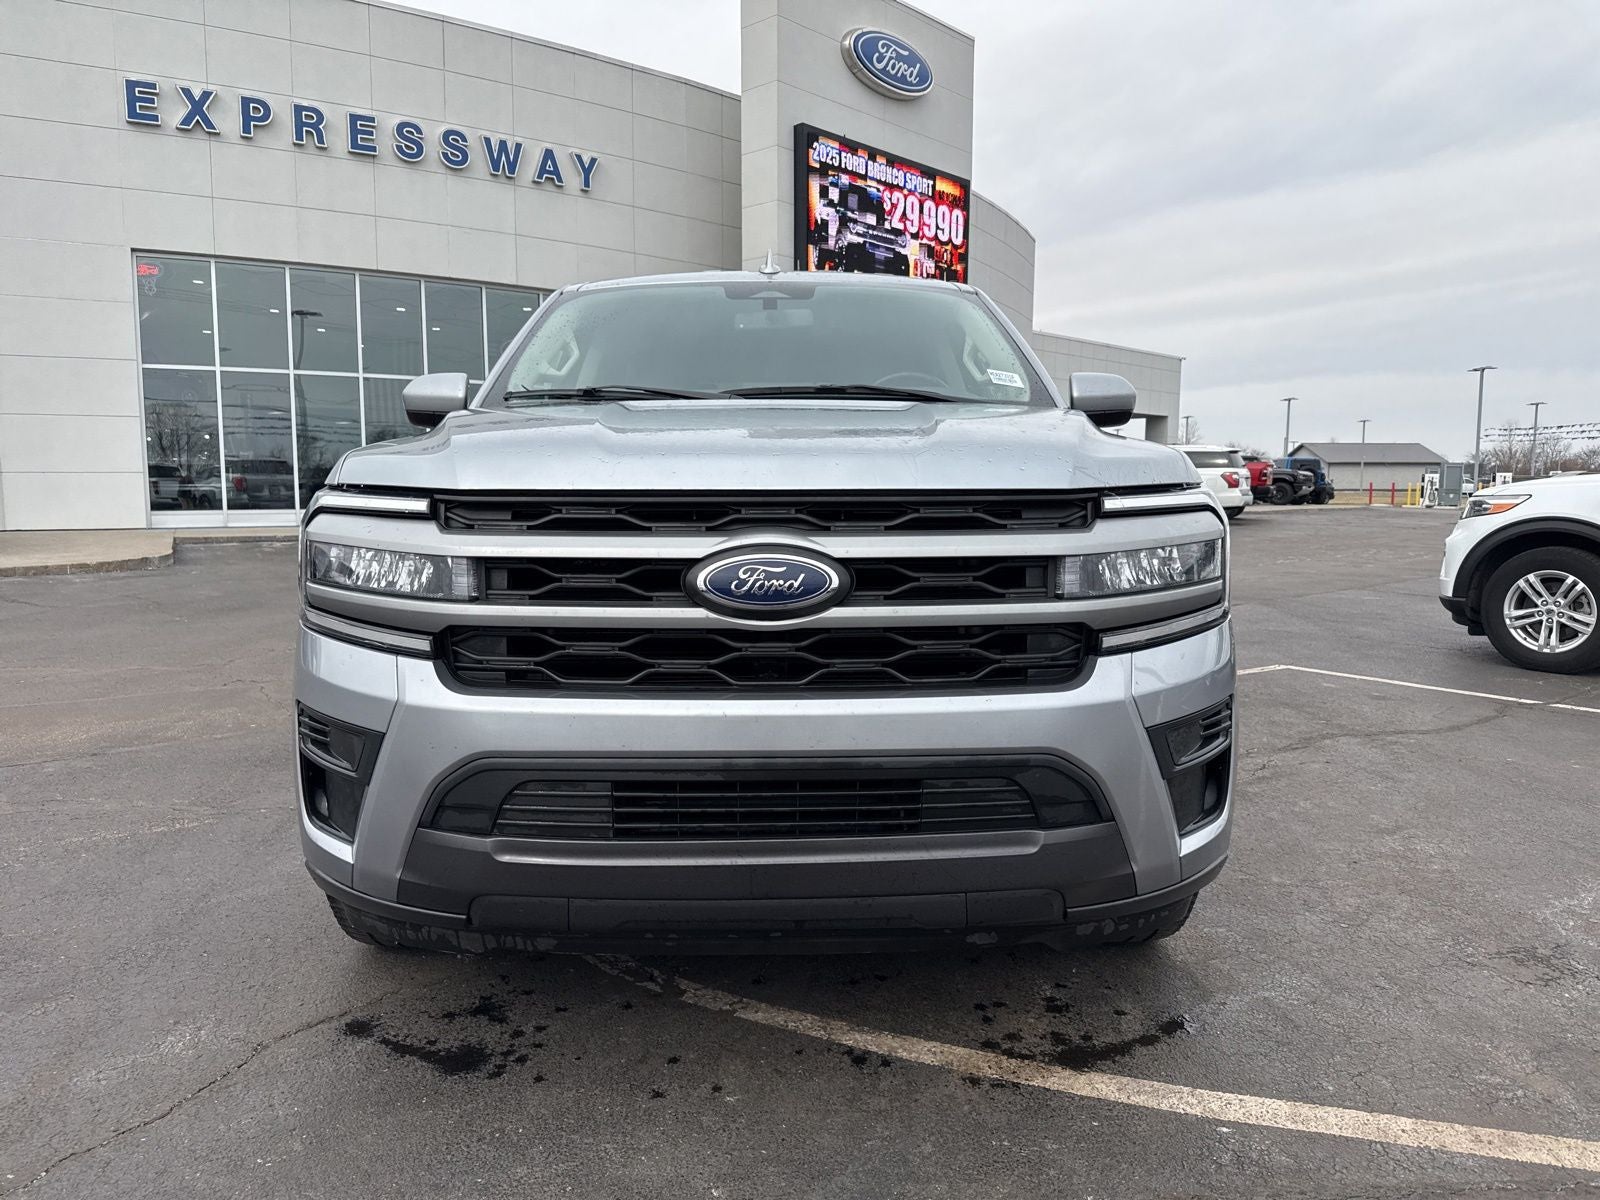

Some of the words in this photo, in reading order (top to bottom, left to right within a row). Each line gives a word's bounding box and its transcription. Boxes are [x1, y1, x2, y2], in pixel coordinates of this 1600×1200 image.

[873, 40, 920, 84] Ford
[123, 77, 599, 191] EXPRESSWAY
[812, 142, 839, 167] 2025
[840, 151, 867, 175] FORD
[867, 160, 905, 187] BRONCO
[905, 171, 934, 197] SPORT
[731, 565, 805, 595] Ford
